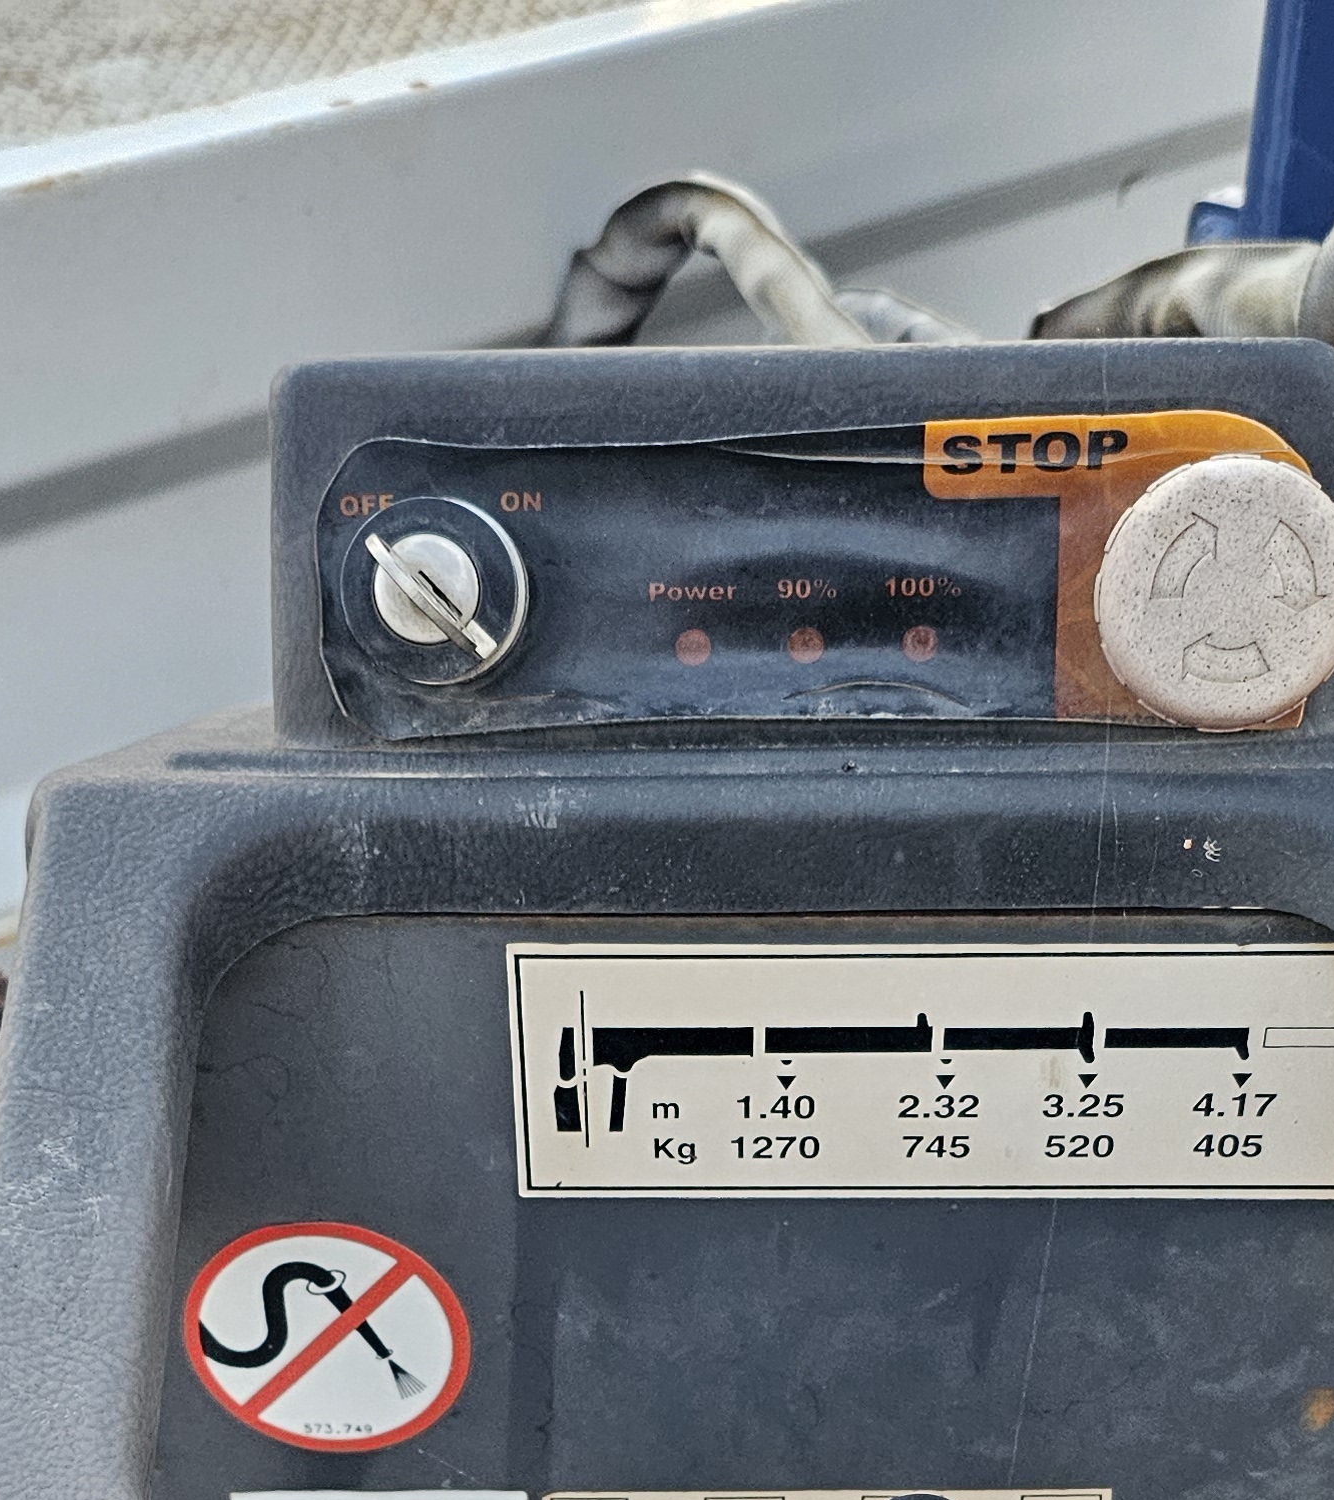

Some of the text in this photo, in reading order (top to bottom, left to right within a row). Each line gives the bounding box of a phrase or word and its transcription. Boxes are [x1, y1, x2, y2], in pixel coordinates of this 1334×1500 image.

[941, 429, 1129, 475] STOP
[340, 491, 542, 517] OFF ON
[648, 576, 961, 602] Power 90% 100%
[652, 1101, 680, 1119] m
[736, 1094, 816, 1120] 1.40
[897, 1094, 980, 1119] 2.32
[1042, 1093, 1125, 1118] 3.25
[1192, 1092, 1277, 1118] 4.17
[653, 1138, 697, 1164] Kg
[730, 1135, 820, 1159] 1270
[902, 1135, 971, 1159] 745
[1044, 1134, 1115, 1158] 520
[1192, 1133, 1264, 1158] 405
